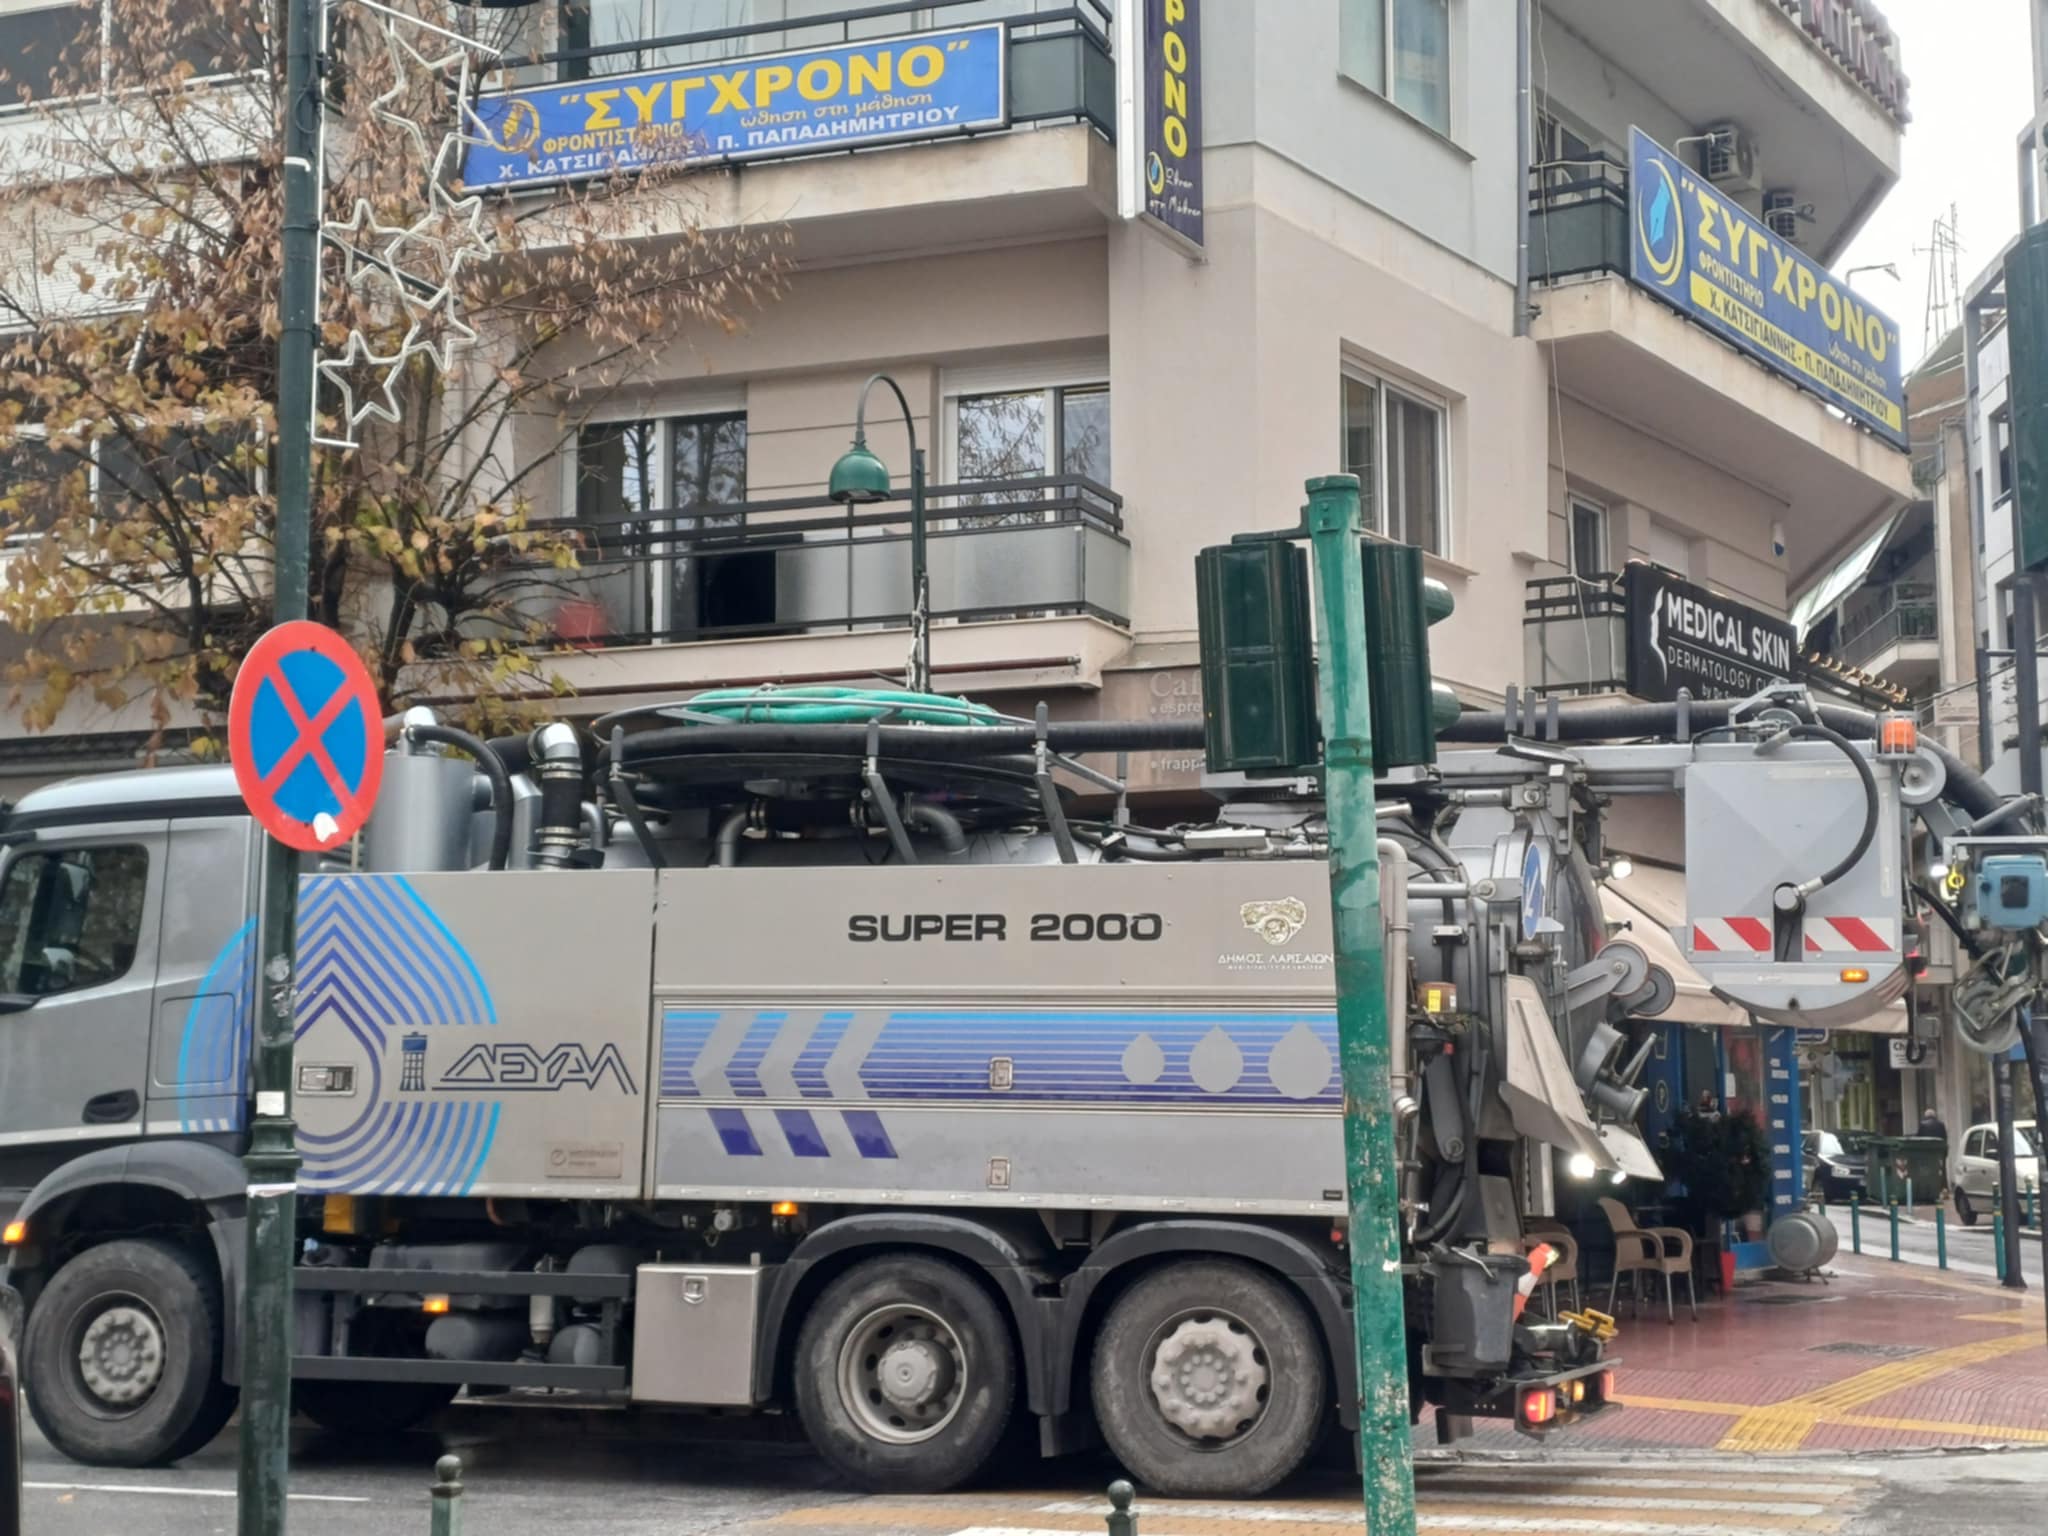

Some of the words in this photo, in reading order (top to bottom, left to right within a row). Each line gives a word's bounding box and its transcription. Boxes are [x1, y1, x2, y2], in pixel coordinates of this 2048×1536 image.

[560, 39, 971, 131] "ΣΥΓΧΡΟΝΟ"
[542, 120, 684, 155] ΦΡΟΝΤΙΣΤΡΙΟ
[717, 134, 740, 150] Π.
[748, 105, 960, 146] ΠΑΠΑΔΗΜΗΤΡΙΟΥ
[1681, 176, 1897, 362] "ΣΥΓΧΡΟΝΟ"
[1699, 250, 1765, 309] ΦΡΟΝΤΙΣΤΗΡΙΟ
[1667, 591, 1748, 656] MEDICAL
[1752, 626, 1790, 673] SKIN
[1668, 645, 1751, 690] DERMATOLOGY
[848, 914, 1007, 943] SUPER
[1030, 913, 1162, 942] 2000
[1217, 953, 1265, 965] ΔΗΜΟΣ
